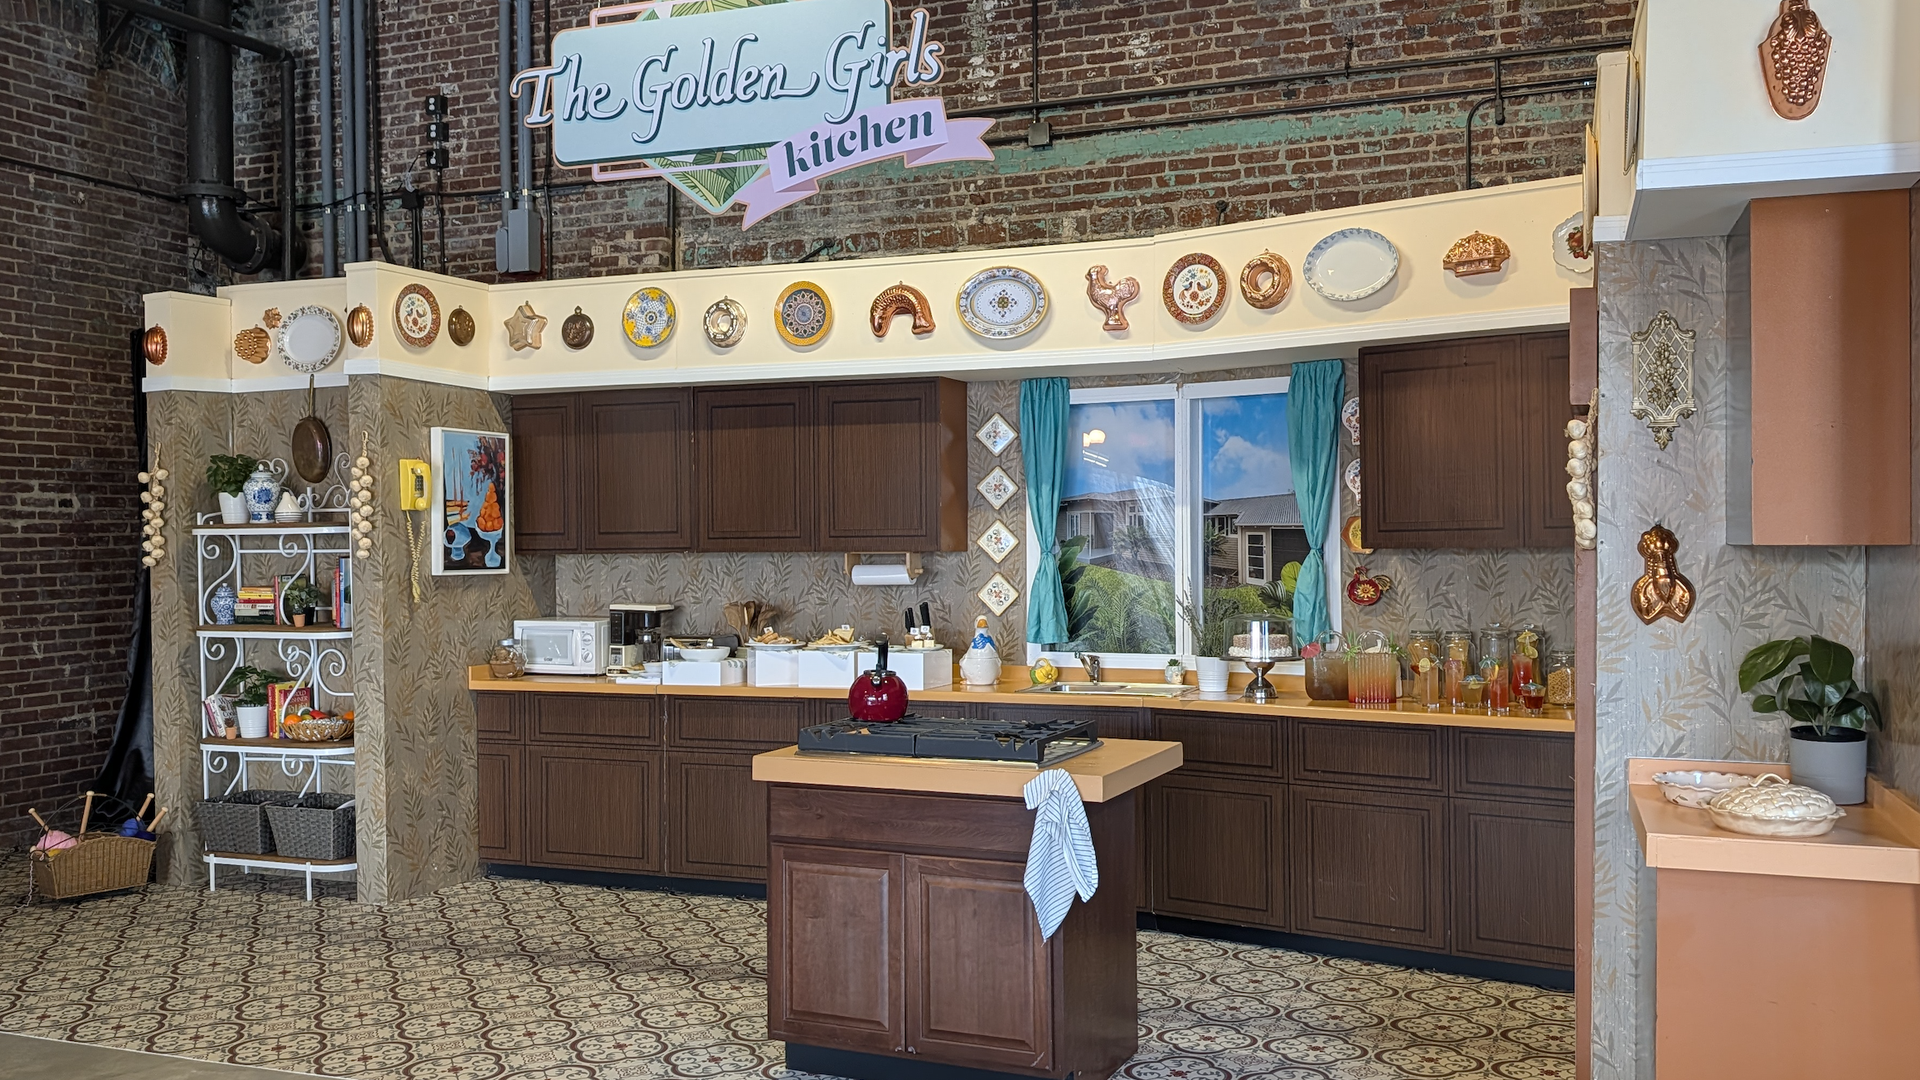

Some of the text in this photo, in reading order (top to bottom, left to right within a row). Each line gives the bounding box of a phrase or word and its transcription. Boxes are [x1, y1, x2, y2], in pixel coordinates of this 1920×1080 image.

[512, 10, 942, 143] The Golden Girls
[783, 109, 936, 178] kitchen
